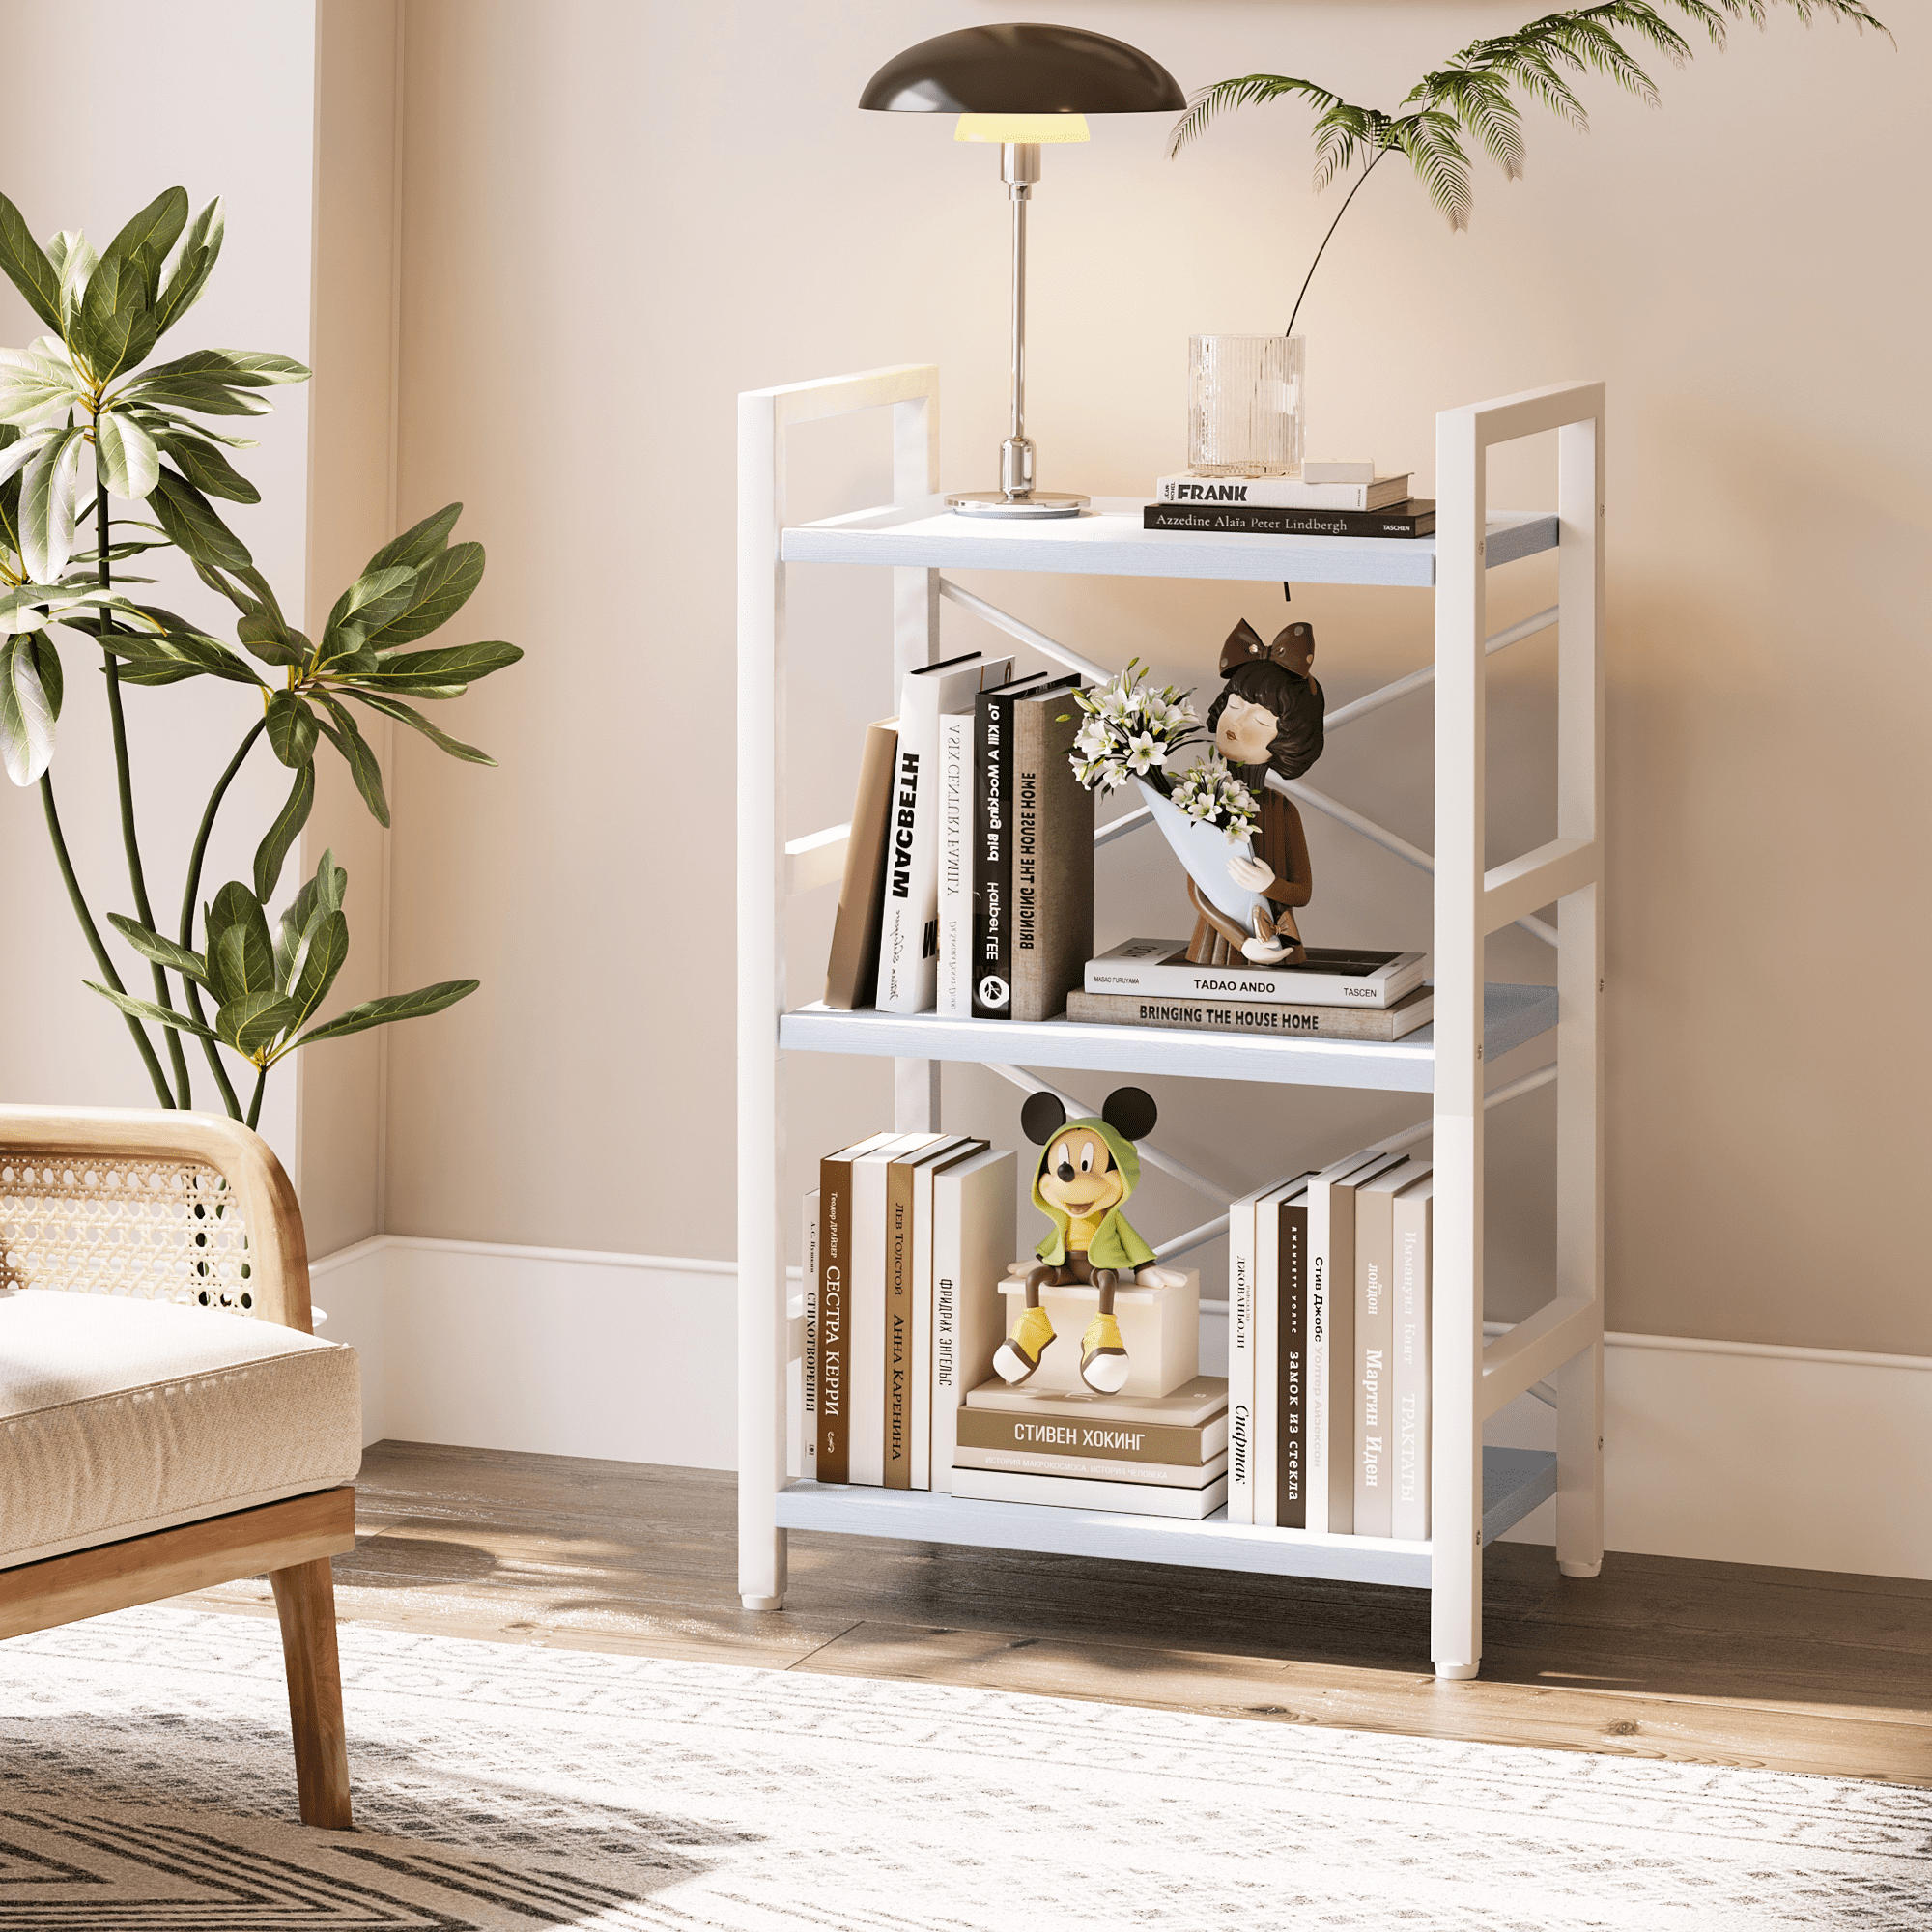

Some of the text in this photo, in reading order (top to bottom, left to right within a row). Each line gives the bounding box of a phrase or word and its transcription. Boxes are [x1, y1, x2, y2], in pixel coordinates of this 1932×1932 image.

[1156, 513, 1348, 534] Azzedine Alaïa Peter Lindbergh
[1178, 484, 1248, 502] FRANK
[1140, 1005, 1319, 1030] BRINGING THE HOUSE HOME
[1193, 979, 1275, 993] TADAO ANDO
[1344, 988, 1377, 998] TASCEN
[938, 1278, 953, 1386] ФРИДРИХ ЭНГЕЛЬС
[1236, 1255, 1245, 1349] ДЖОВАНЬОЛИ
[1402, 1231, 1416, 1365] Иммануил Кант
[806, 1292, 816, 1412] СТИХОТВОРЕНИЯ
[824, 1265, 840, 1416] СЕСТРА КЕРРИ
[1313, 1257, 1323, 1467] Стив Джобс Уолтер Айзексон
[1014, 1423, 1145, 1451] СТИВЕН ХОКИНГ
[1232, 1405, 1249, 1485] Спартак
[1289, 1413, 1299, 1434] из
[1362, 1349, 1382, 1487] Мартин Иден
[1401, 1393, 1415, 1502] ТРАКТАТЫ
[985, 1456, 1021, 1466] ИСТОРИЯ
[1090, 1465, 1126, 1476] ИСТОРИЯ
[1128, 1468, 1168, 1480] ЧЕЛОВЕКА
[1289, 1440, 1299, 1501] стекла
